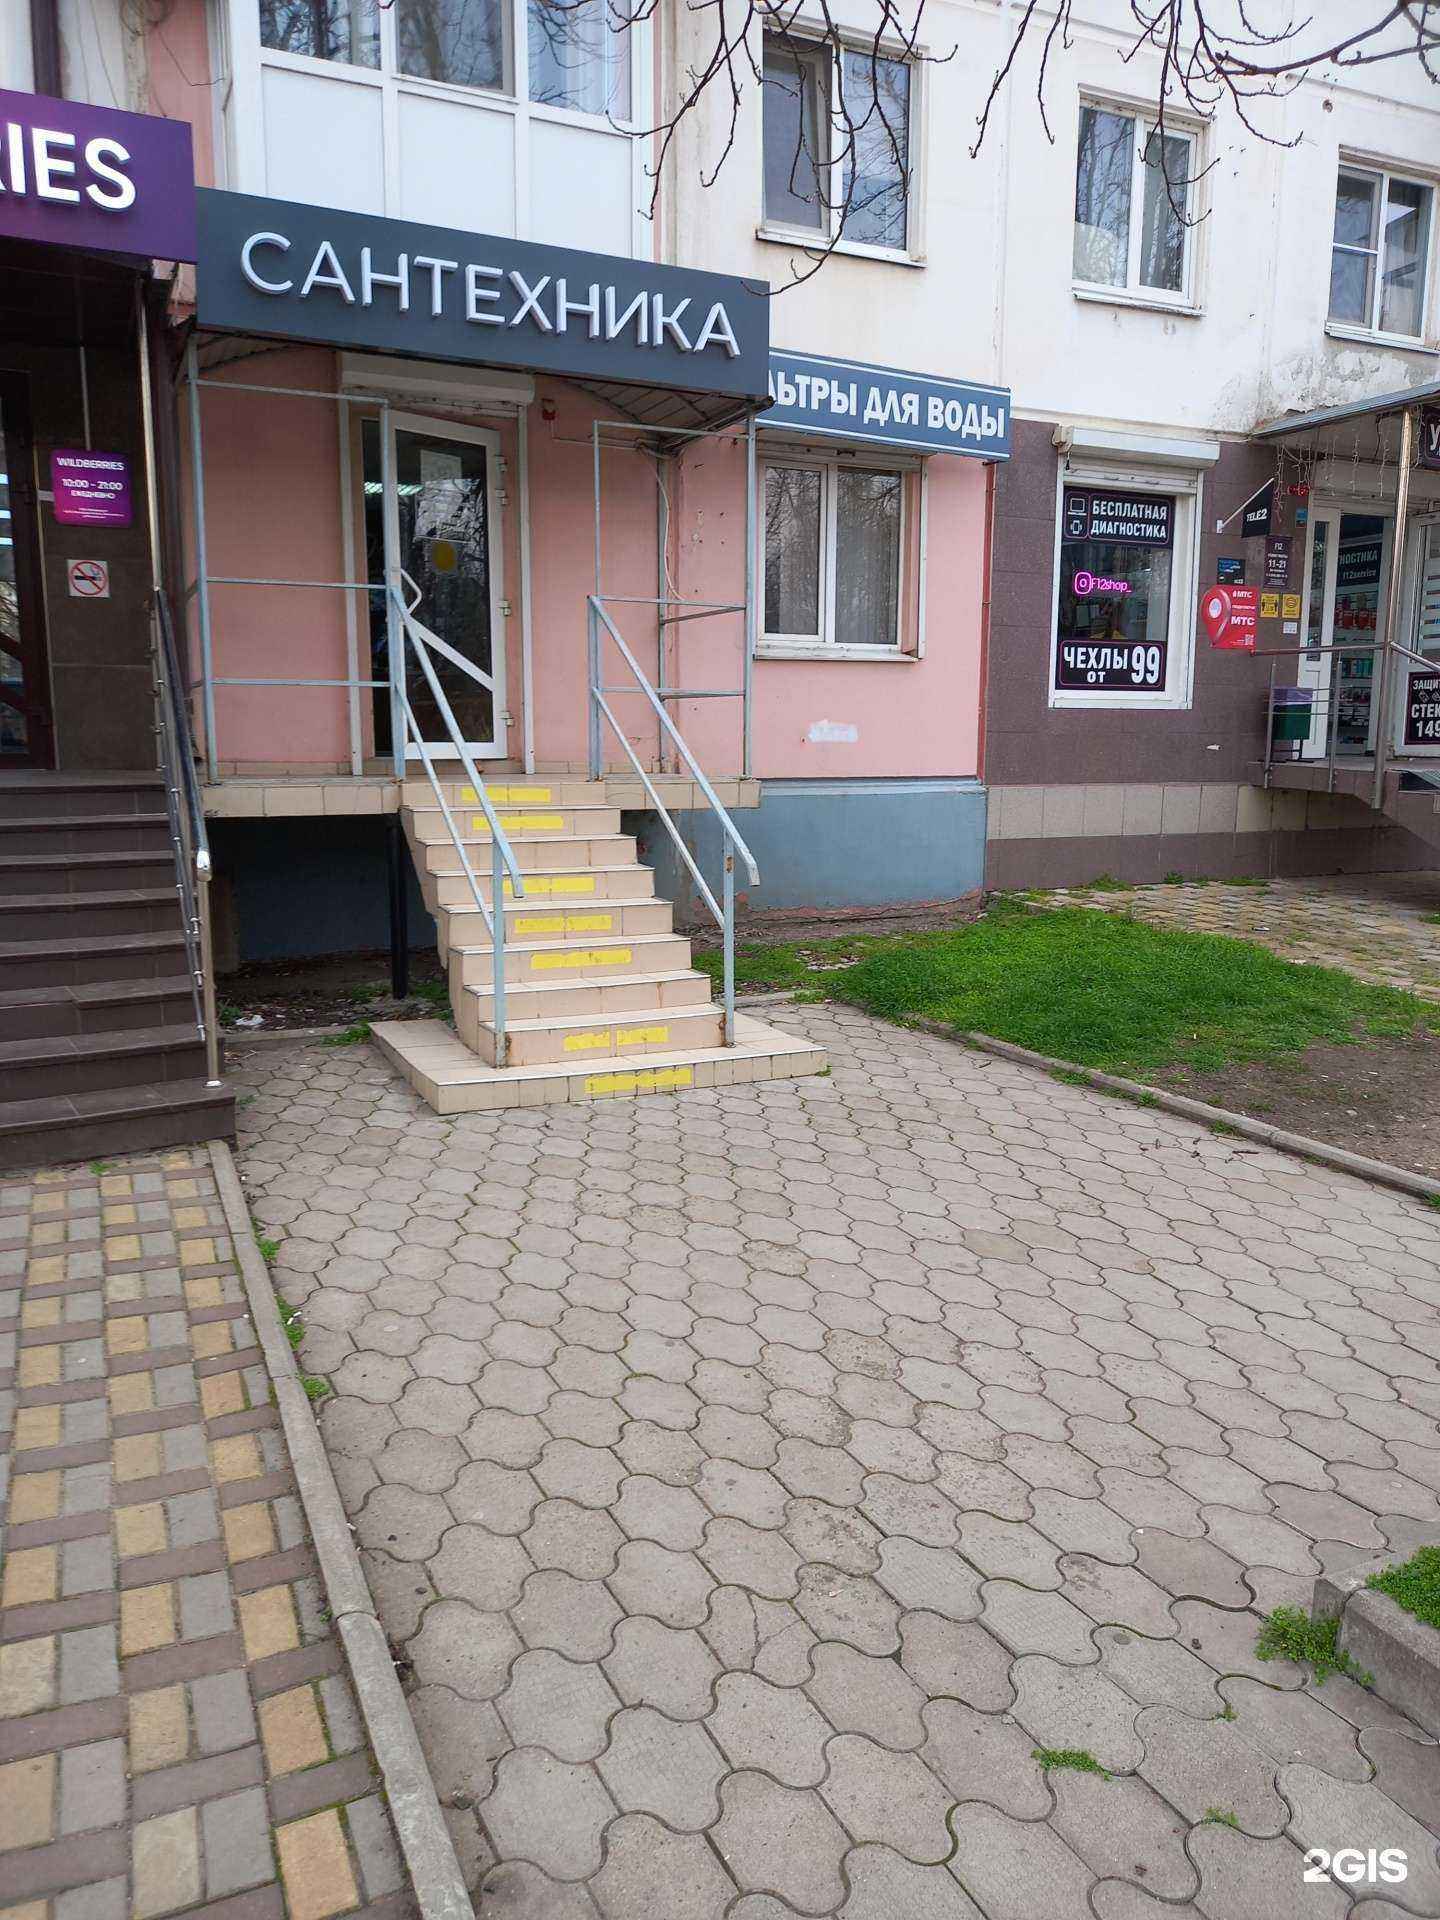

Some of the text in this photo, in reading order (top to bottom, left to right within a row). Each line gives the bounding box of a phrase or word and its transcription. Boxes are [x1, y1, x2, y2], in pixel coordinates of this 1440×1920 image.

[0, 122, 136, 211] IES
[240, 230, 741, 359] САНТЕХНИКА
[863, 386, 919, 427] ДЛЯ
[927, 396, 1005, 441] ВОДЫ
[56, 457, 124, 471] WILDBERRIES
[1092, 500, 1168, 520] БЕСПЛАТНАЯ
[1246, 508, 1268, 522] TELE2
[1091, 520, 1167, 538] ДИАГНОСТИКА
[1231, 616, 1255, 626] МТС
[1063, 646, 1129, 670] ЧЕХЛЫ
[1131, 645, 1160, 684] 99
